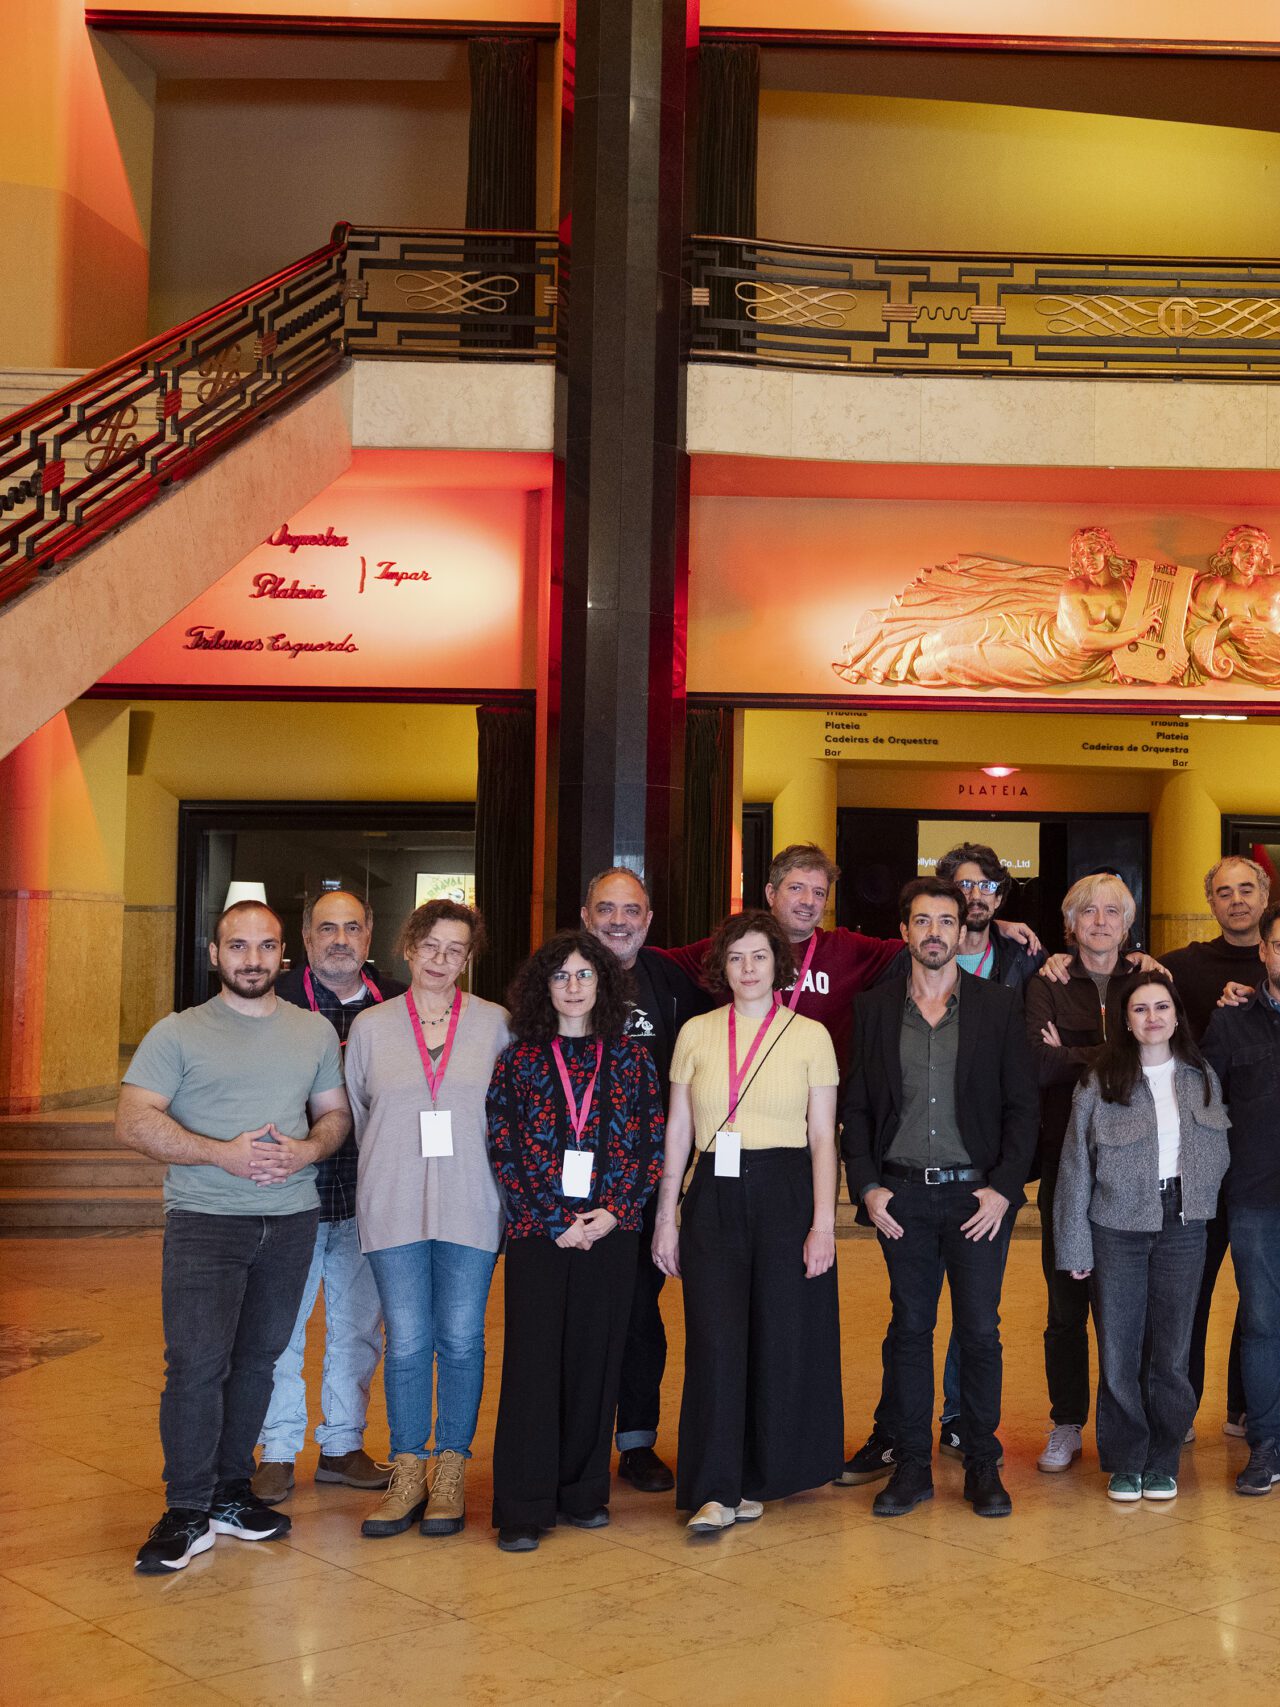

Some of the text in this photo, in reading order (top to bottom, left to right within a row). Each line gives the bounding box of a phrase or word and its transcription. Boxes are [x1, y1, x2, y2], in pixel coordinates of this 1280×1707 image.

[249, 572, 328, 599] Plateia
[183, 625, 264, 651] Tribunas
[825, 721, 860, 730] Plateia
[824, 735, 939, 746] Cadeiras de Orquestra
[1156, 732, 1189, 740] Plateia
[824, 748, 842, 757] Bar
[1082, 742, 1189, 754] Cadeiras de Orquestra
[1172, 759, 1188, 767] Bar
[958, 784, 1028, 796] PLATEIA
